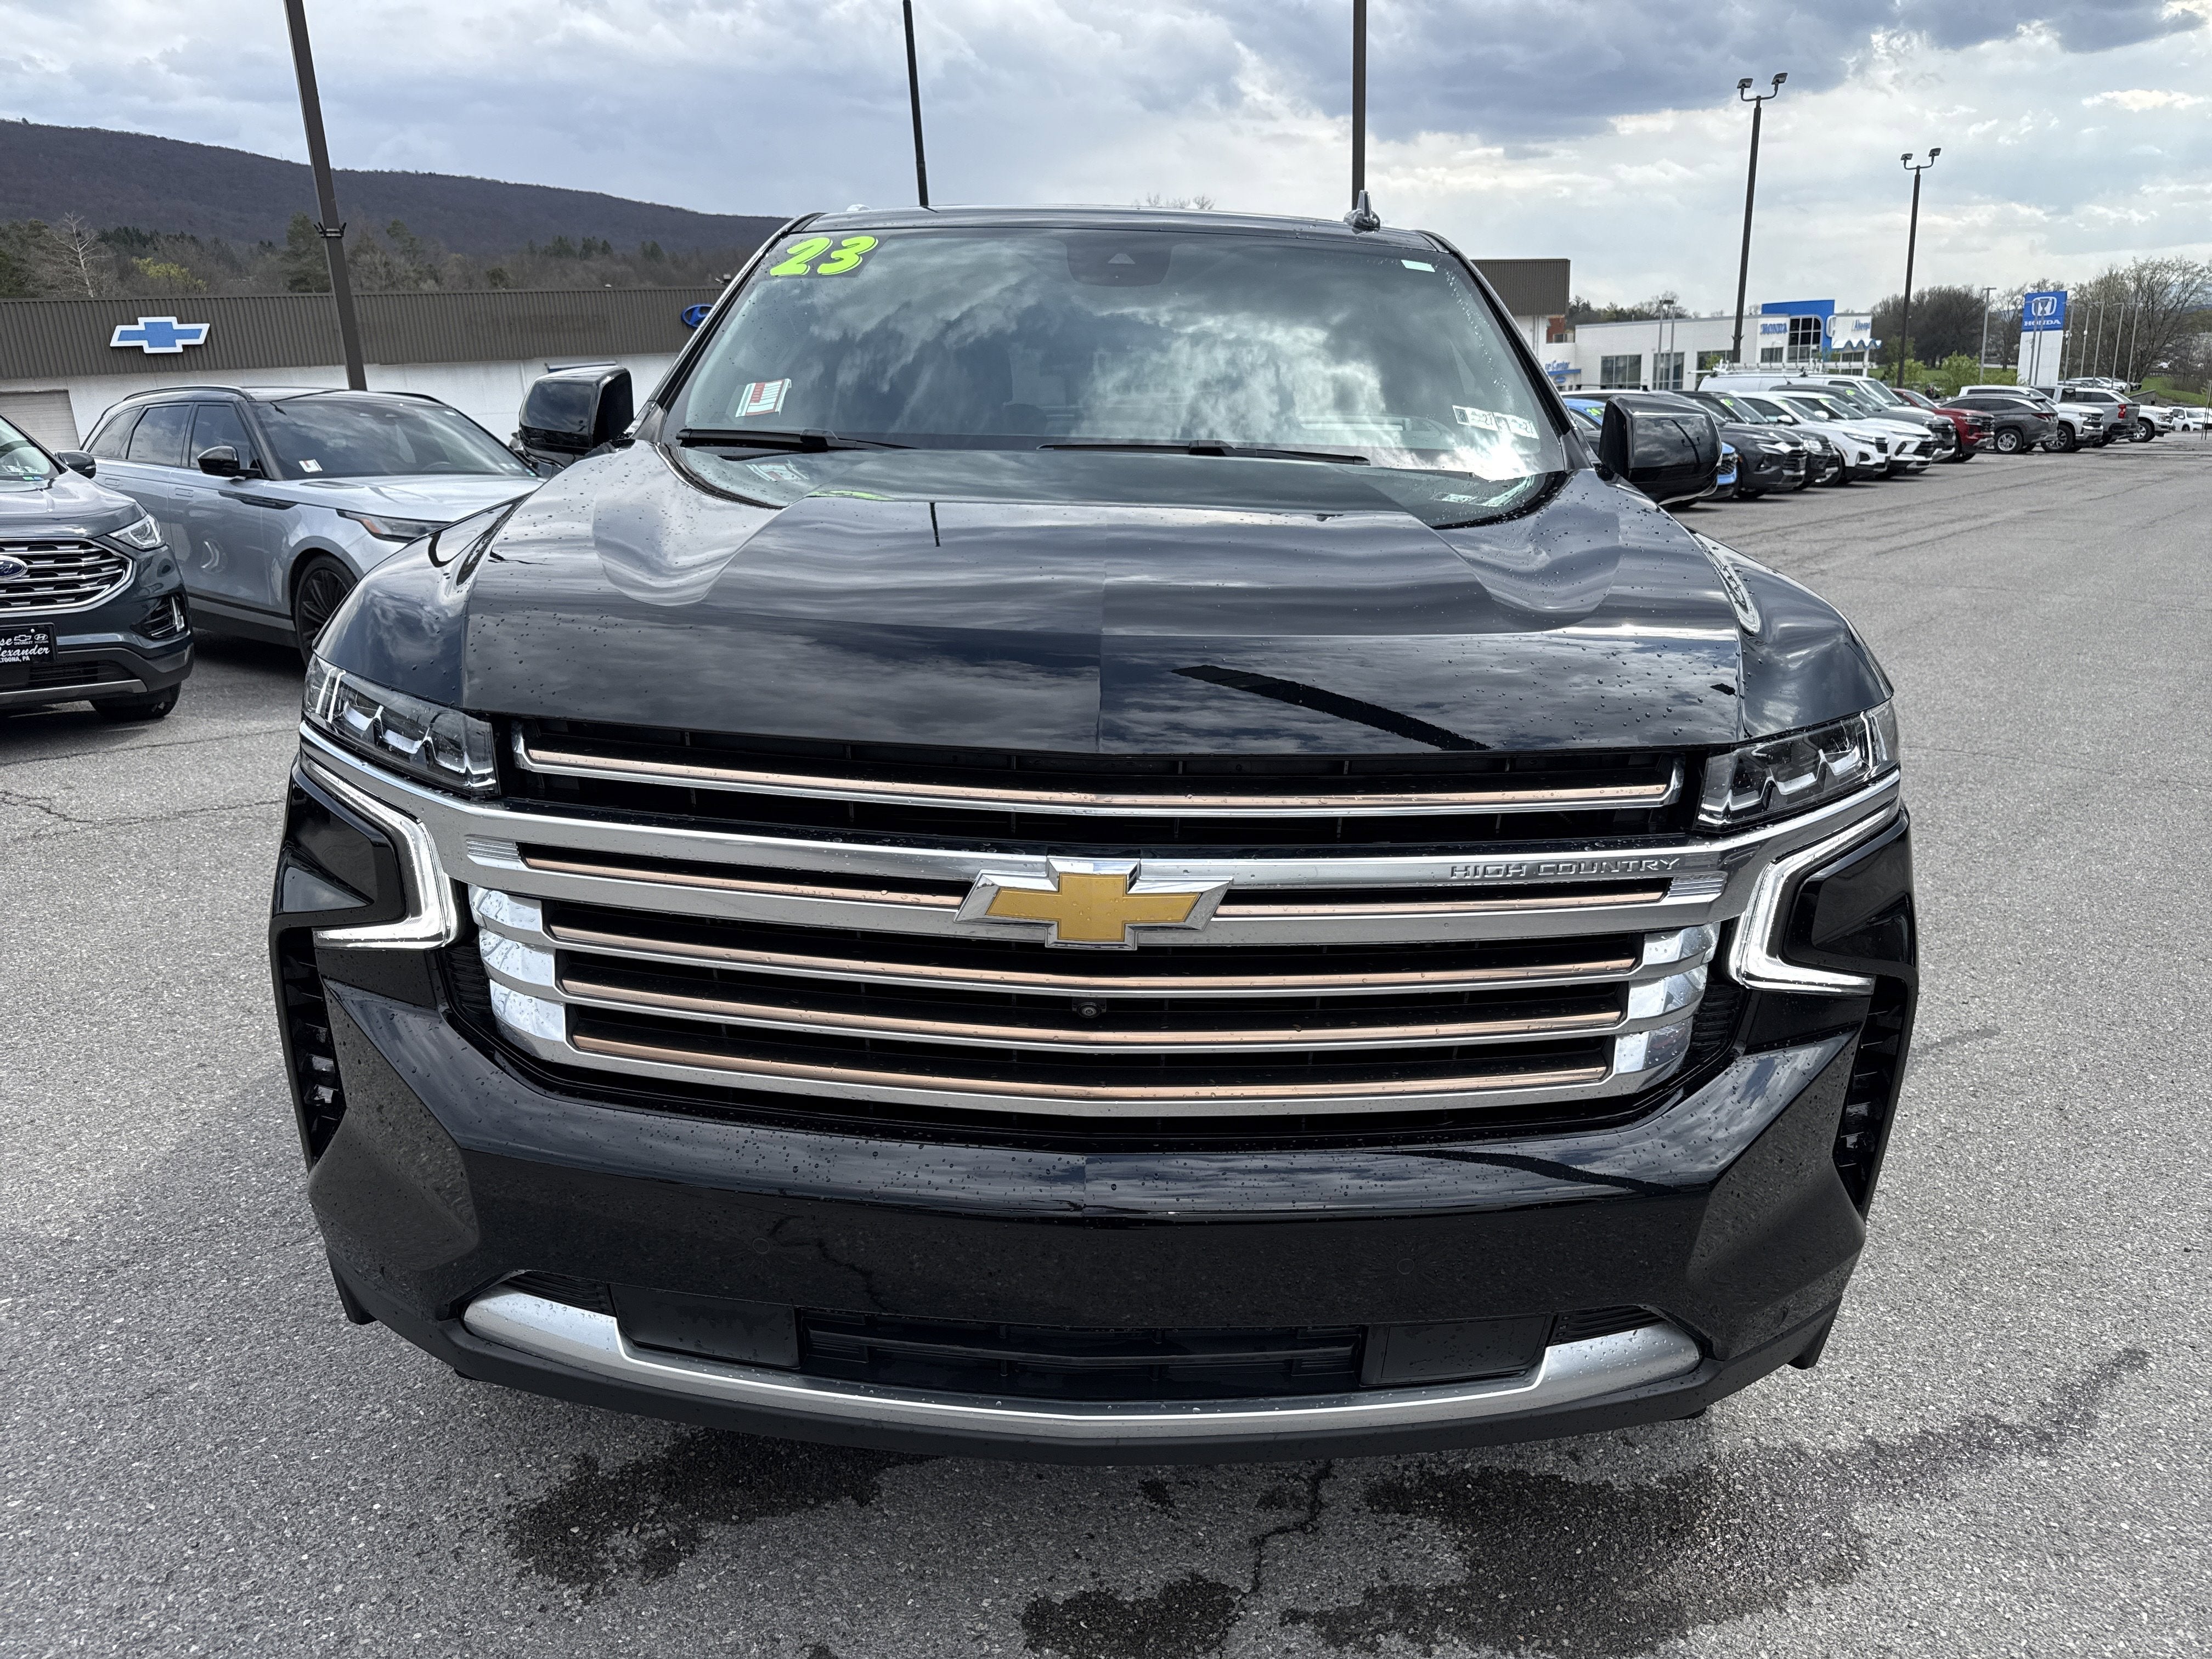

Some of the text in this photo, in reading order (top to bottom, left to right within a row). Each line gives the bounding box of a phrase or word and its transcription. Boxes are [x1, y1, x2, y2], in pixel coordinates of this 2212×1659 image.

[770, 236, 878, 276] 23
[0, 644, 50, 657] exander
[1451, 857, 1680, 878] HIGH COUNTRY
